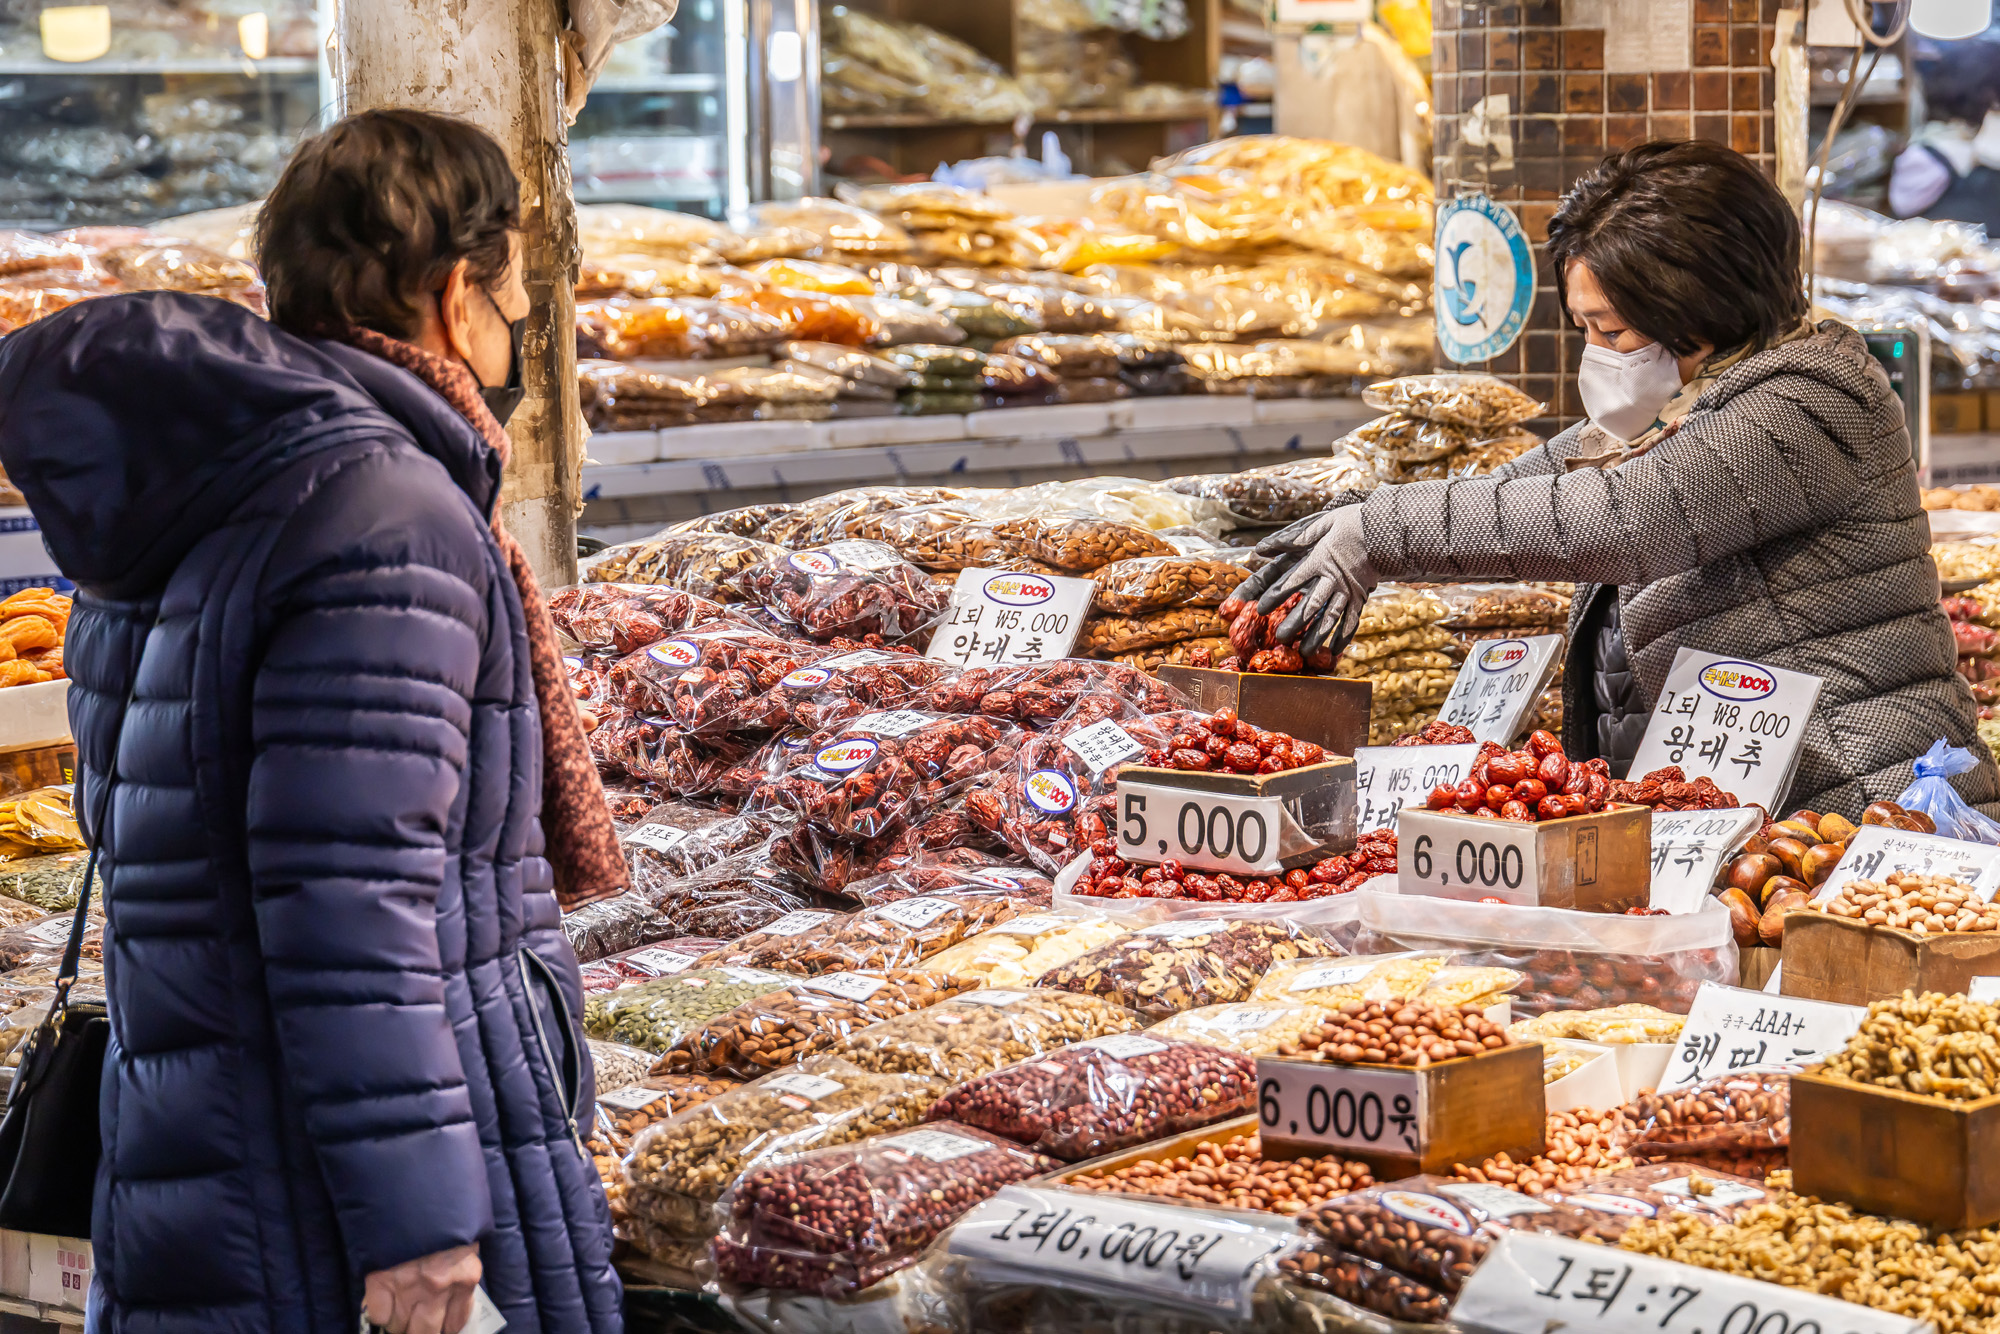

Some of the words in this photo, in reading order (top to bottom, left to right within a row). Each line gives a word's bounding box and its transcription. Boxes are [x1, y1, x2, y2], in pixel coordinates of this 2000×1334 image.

[988, 580, 1020, 595] 국내산
[1019, 583, 1050, 598] 100%
[948, 604, 984, 629] 1되
[995, 609, 1068, 634] ₩5,000
[953, 630, 1044, 665] 약대추
[1704, 668, 1740, 688] 국내산
[1738, 674, 1771, 692] 100%
[1661, 691, 1701, 722] 1되
[1712, 702, 1790, 738] ₩8,000
[846, 747, 875, 761] 100%
[1097, 725, 1135, 754] 왕대추
[1663, 724, 1762, 780] 왕대추
[1123, 793, 1267, 863] 5,000
[1414, 834, 1524, 889] 6,000
